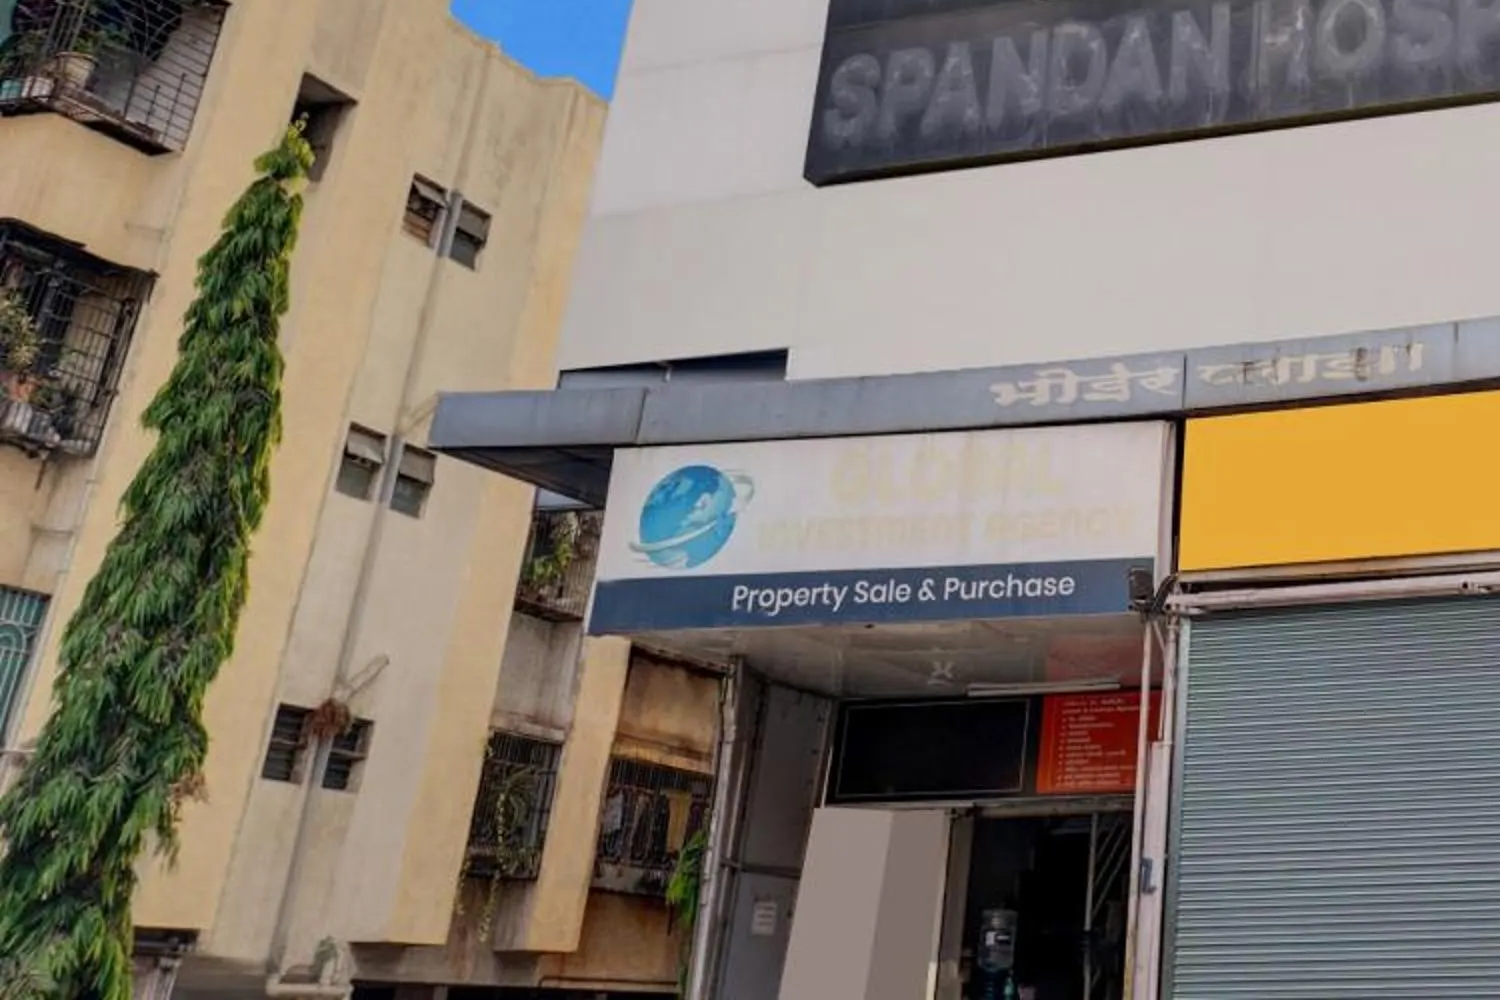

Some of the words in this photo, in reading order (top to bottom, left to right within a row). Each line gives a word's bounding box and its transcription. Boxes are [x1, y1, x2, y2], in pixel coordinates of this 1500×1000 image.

[823, 1, 1231, 146] SPANDAN
[732, 583, 848, 617] Property
[853, 578, 911, 604] Sale
[918, 577, 937, 602] &
[943, 573, 1076, 602] Purchase
